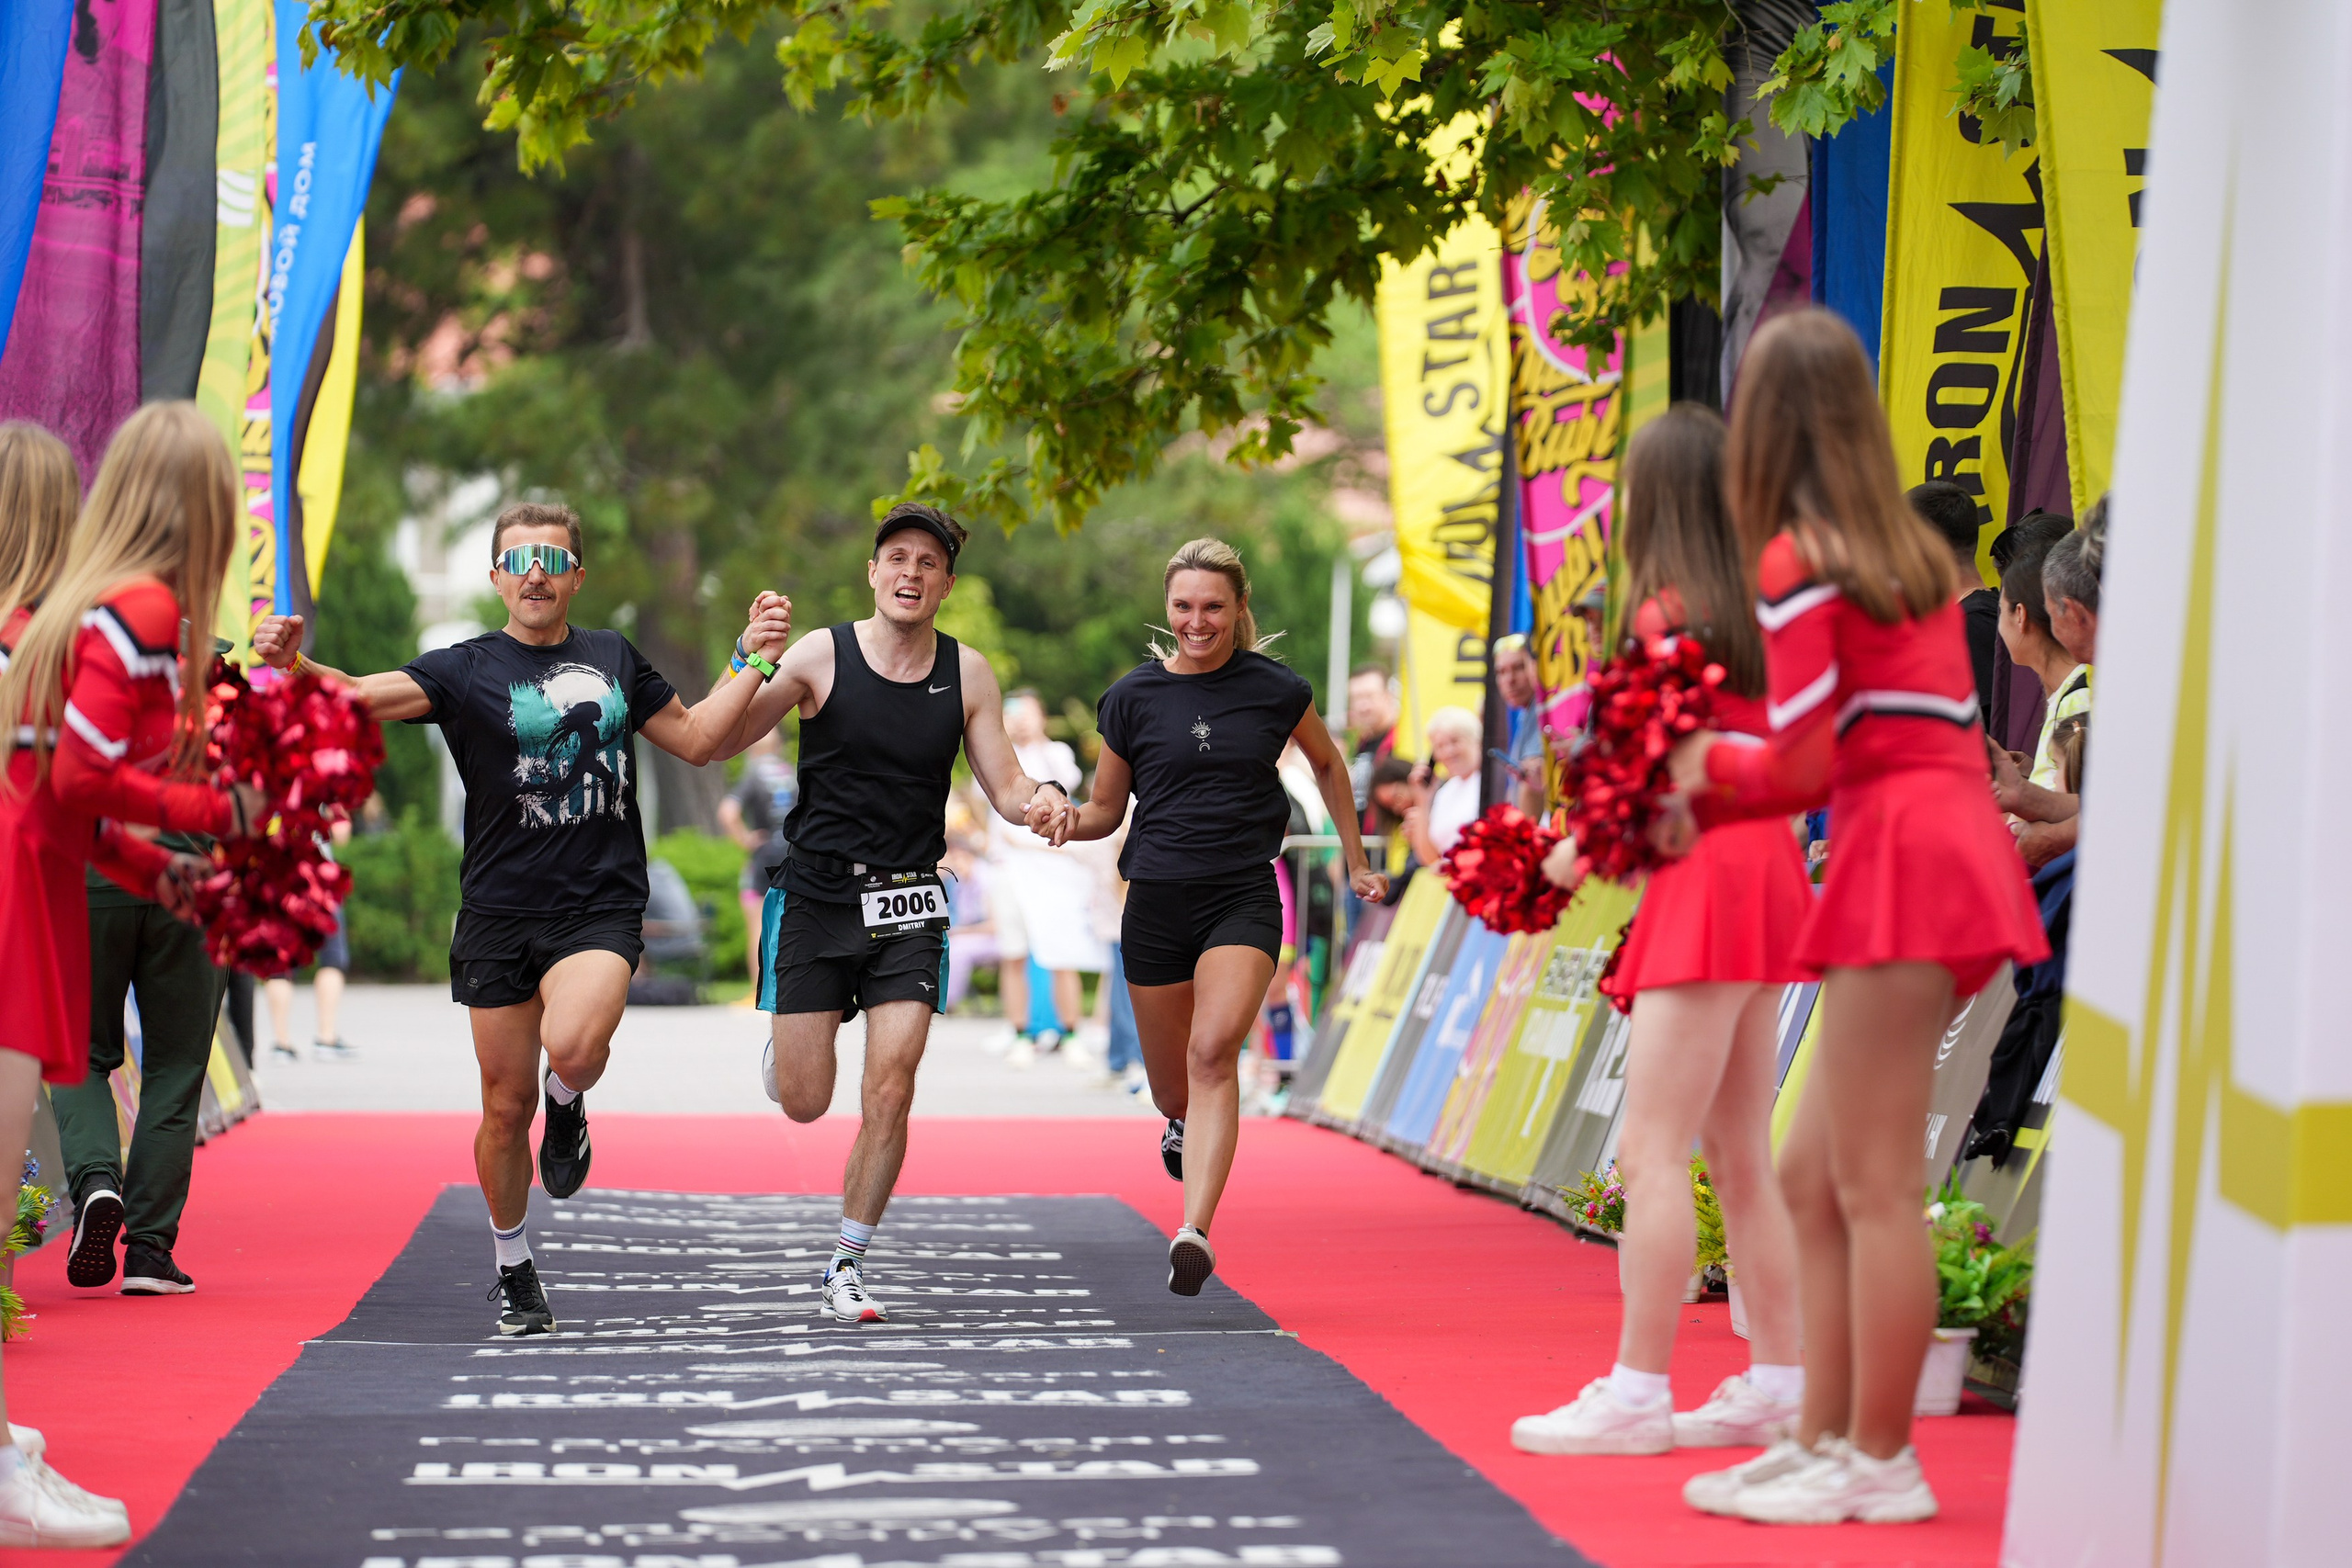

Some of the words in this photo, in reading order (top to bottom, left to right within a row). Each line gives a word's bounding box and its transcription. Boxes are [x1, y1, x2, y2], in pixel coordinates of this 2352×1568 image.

[1422, 261, 1479, 417] STAR
[1925, 287, 2017, 525] RON
[877, 890, 936, 919] 2006
[898, 921, 925, 931] DMITRIY
[537, 1243, 741, 1255] IRON
[861, 1320, 1114, 1329] STAR
[472, 1344, 728, 1355] IRON
[864, 1337, 1136, 1348] STAR
[449, 1390, 733, 1404] IRON
[888, 1388, 1193, 1404] STAR
[413, 1462, 739, 1479] IRON
[913, 1458, 1259, 1476] STAR
